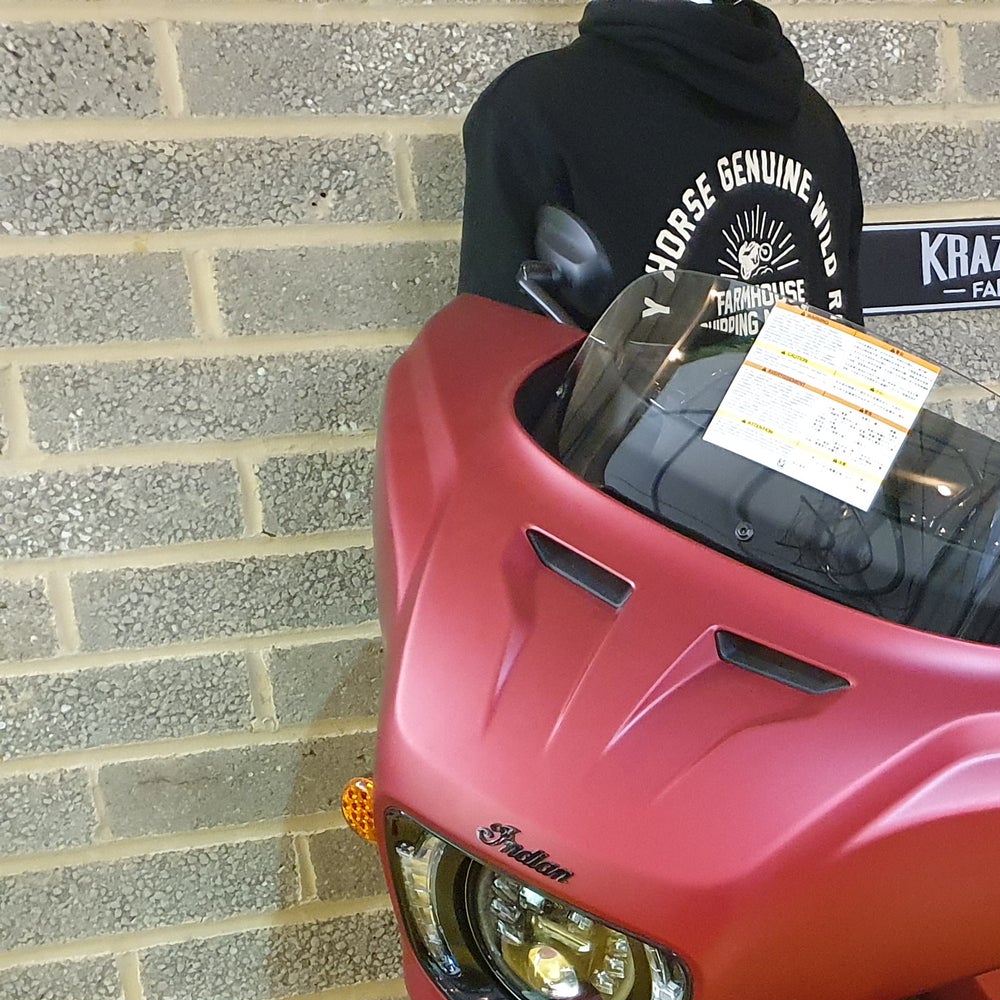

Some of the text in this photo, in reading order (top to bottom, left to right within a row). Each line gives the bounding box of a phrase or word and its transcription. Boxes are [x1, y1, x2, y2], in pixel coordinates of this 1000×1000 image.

[645, 172, 716, 282] HORSE
[717, 149, 813, 203] GENUINE
[810, 191, 838, 278] WILD
[716, 279, 806, 316] FARMHOUSE
[475, 822, 574, 884] Indian
